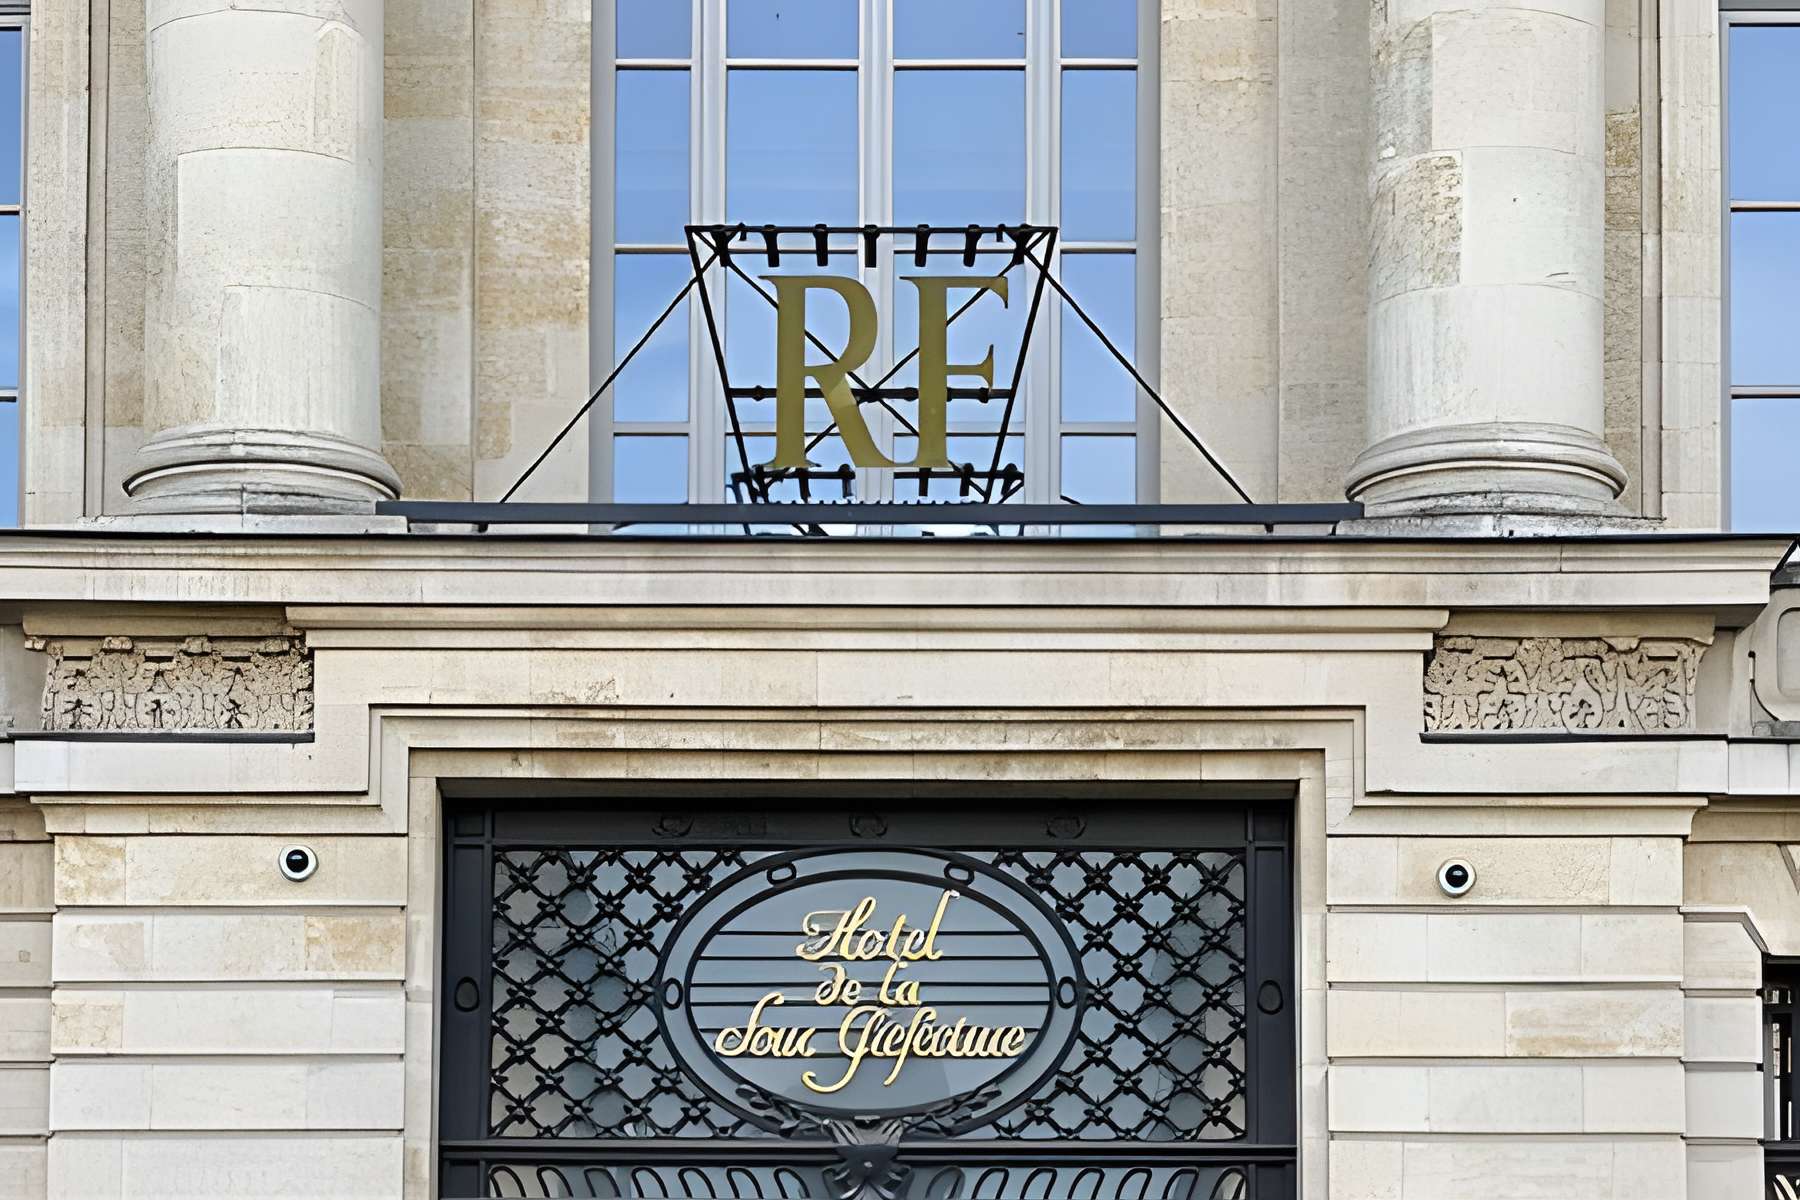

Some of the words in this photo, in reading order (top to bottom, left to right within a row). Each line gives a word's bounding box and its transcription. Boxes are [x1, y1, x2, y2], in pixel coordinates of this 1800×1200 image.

[757, 275, 1009, 468] RF
[796, 889, 960, 961] Hotel
[814, 962, 862, 1005] de
[878, 961, 922, 1005] la
